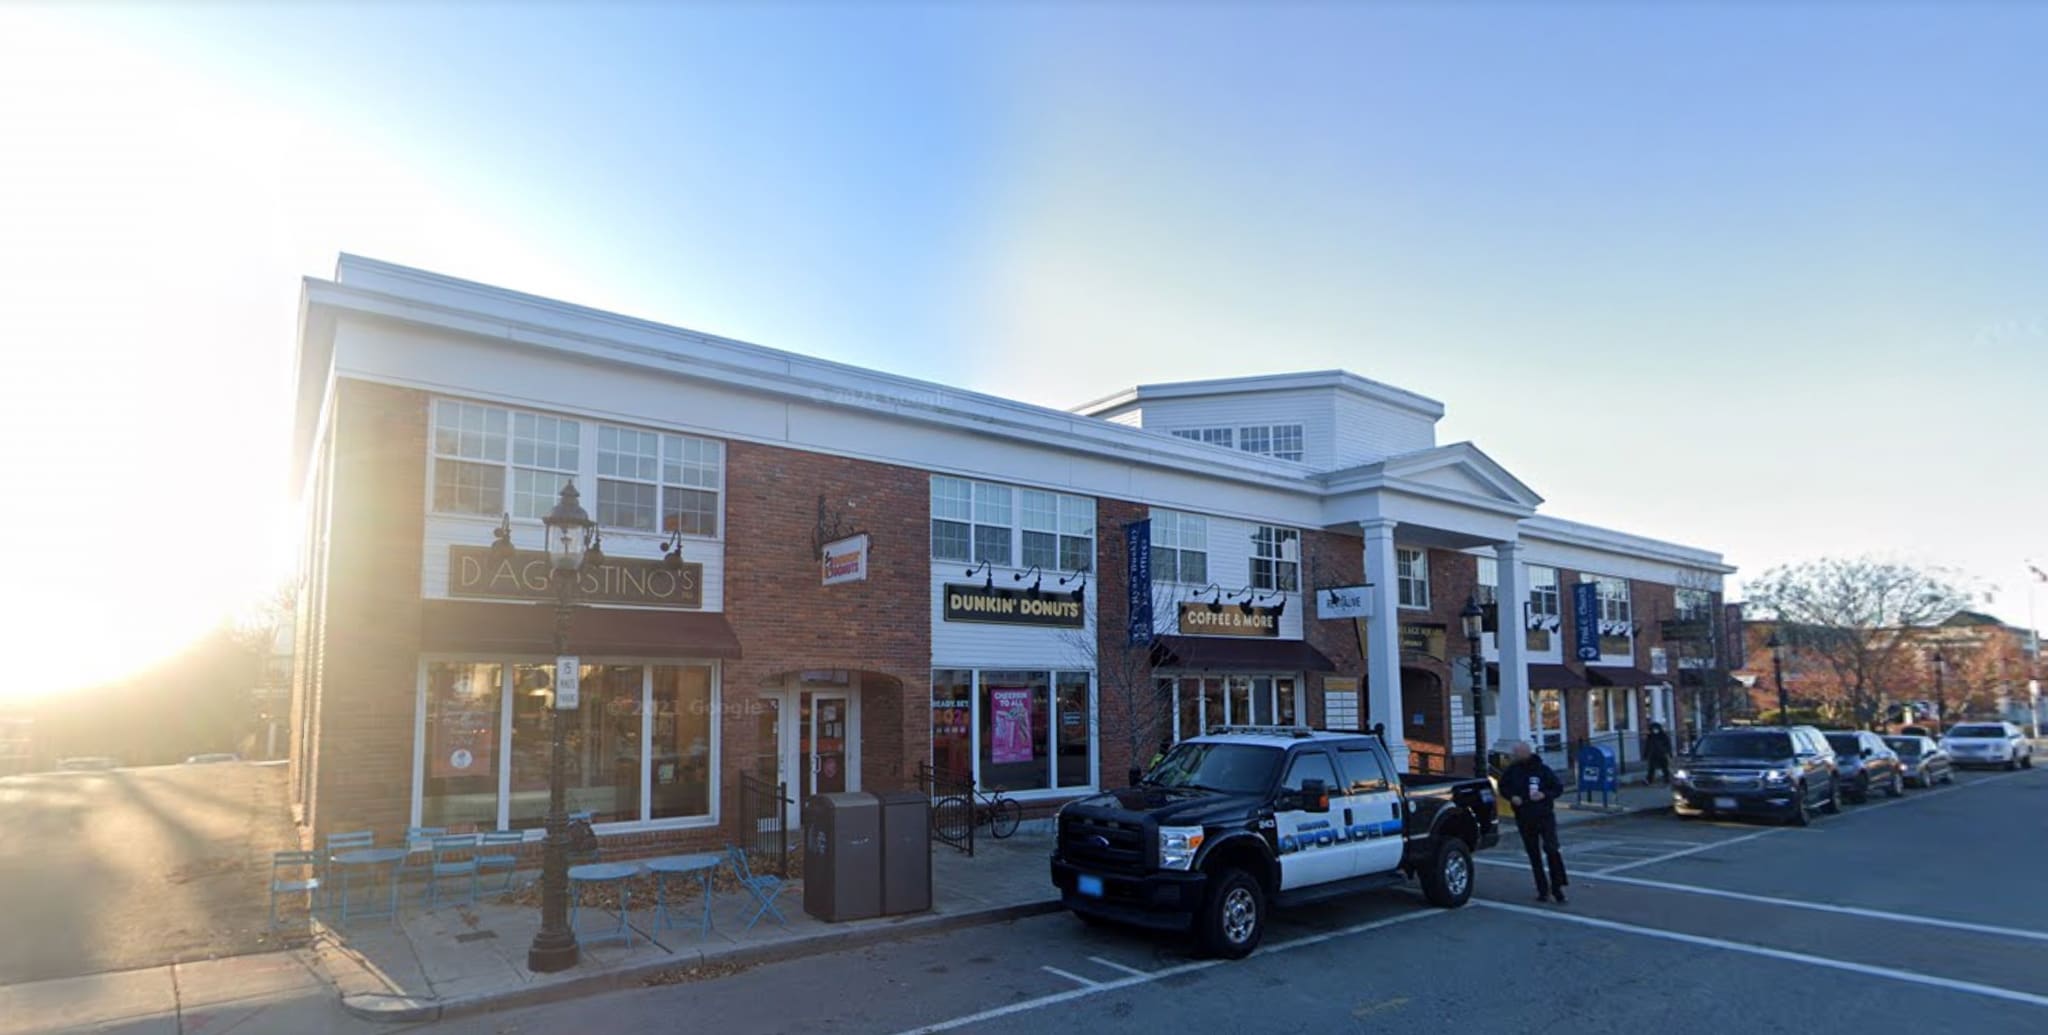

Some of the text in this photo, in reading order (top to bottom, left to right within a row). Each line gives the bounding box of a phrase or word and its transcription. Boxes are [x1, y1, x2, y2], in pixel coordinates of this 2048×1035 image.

[461, 556, 694, 598] DAGSTINO'S
[950, 593, 1079, 618] DUNKIN' DONUTS
[1187, 610, 1274, 629] COFFEE & MORE
[1298, 823, 1382, 852] POLICE
